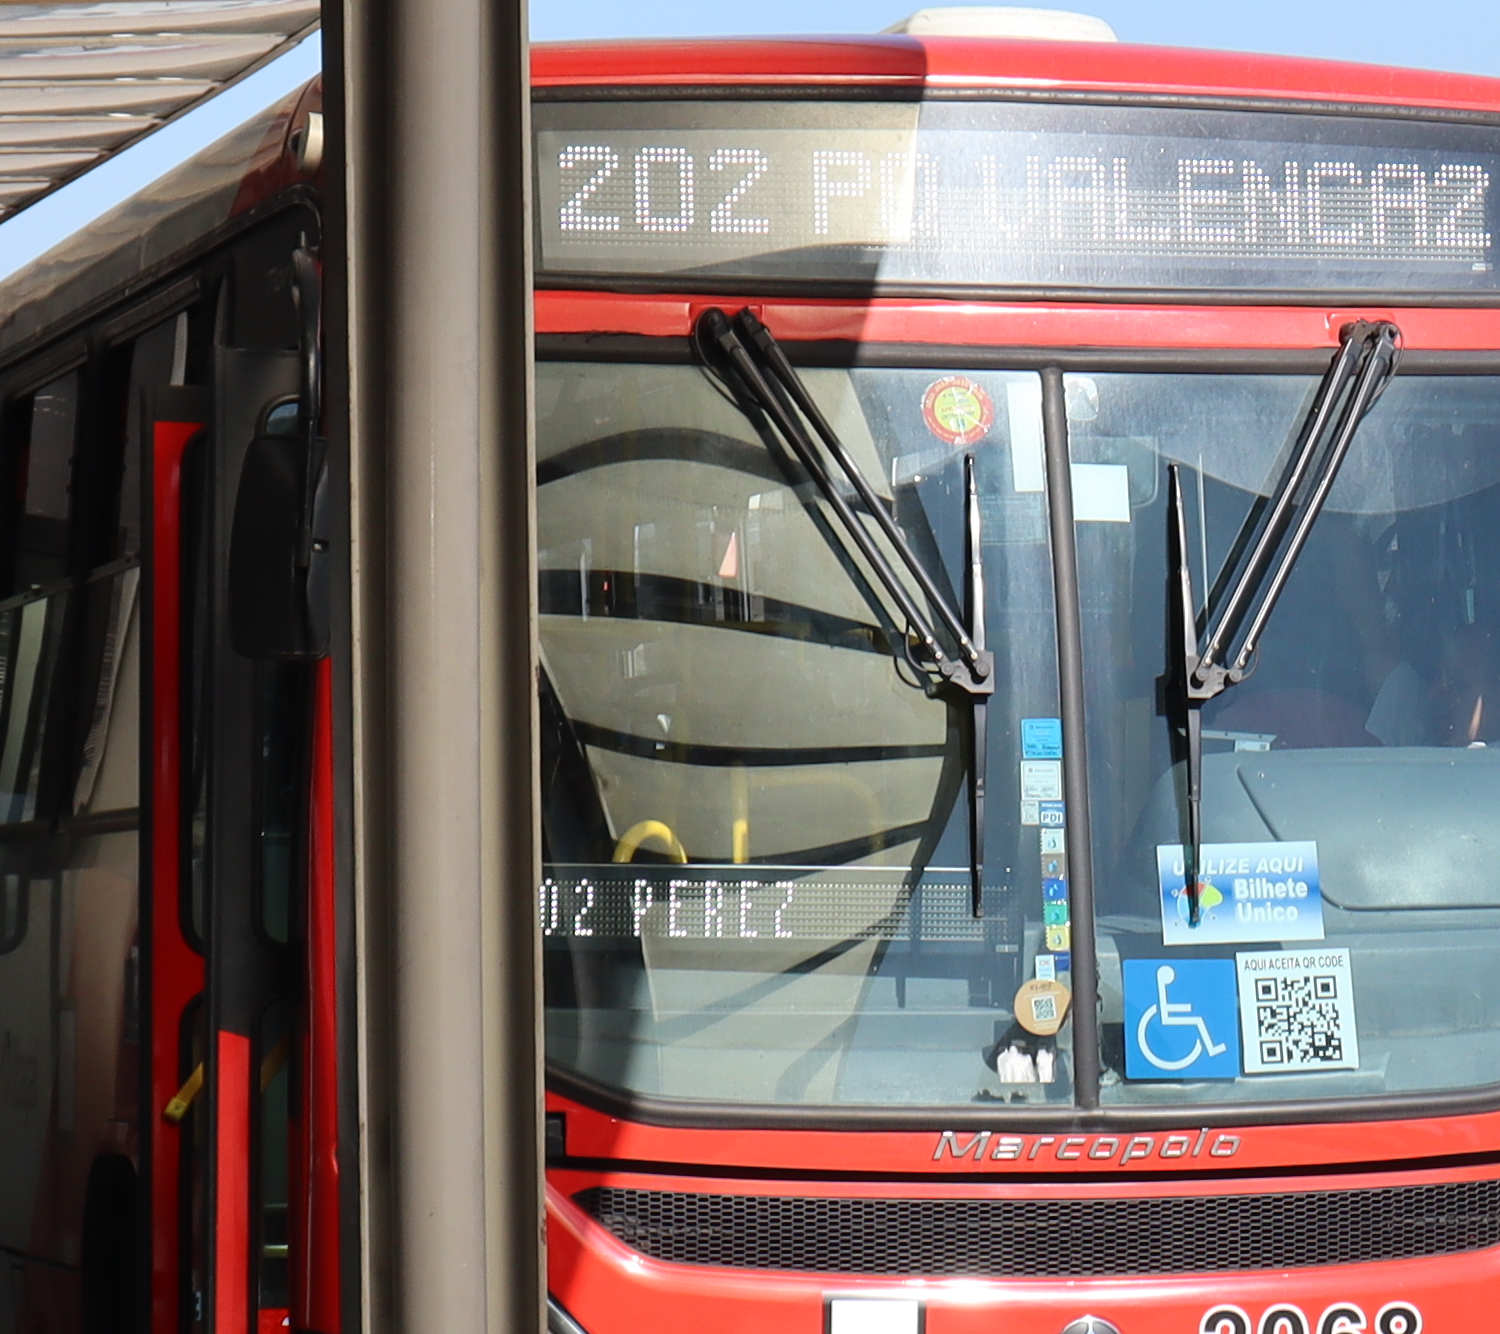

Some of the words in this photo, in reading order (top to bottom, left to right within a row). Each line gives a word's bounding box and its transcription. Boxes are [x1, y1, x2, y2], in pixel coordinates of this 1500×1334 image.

[556, 143, 772, 236] 202
[974, 153, 1494, 249] VALENCA2
[1172, 857, 1250, 876] UILIZE
[1256, 856, 1304, 874] AQUI
[1234, 878, 1310, 899] Bilhete
[538, 877, 594, 937] 02
[632, 878, 795, 938] PEREZ
[1244, 957, 1267, 970] AQUI
[1268, 956, 1302, 971] ACEITA
[1303, 956, 1317, 969] QR
[1318, 954, 1345, 968] CODE
[933, 1127, 1242, 1166] Marcopolo
